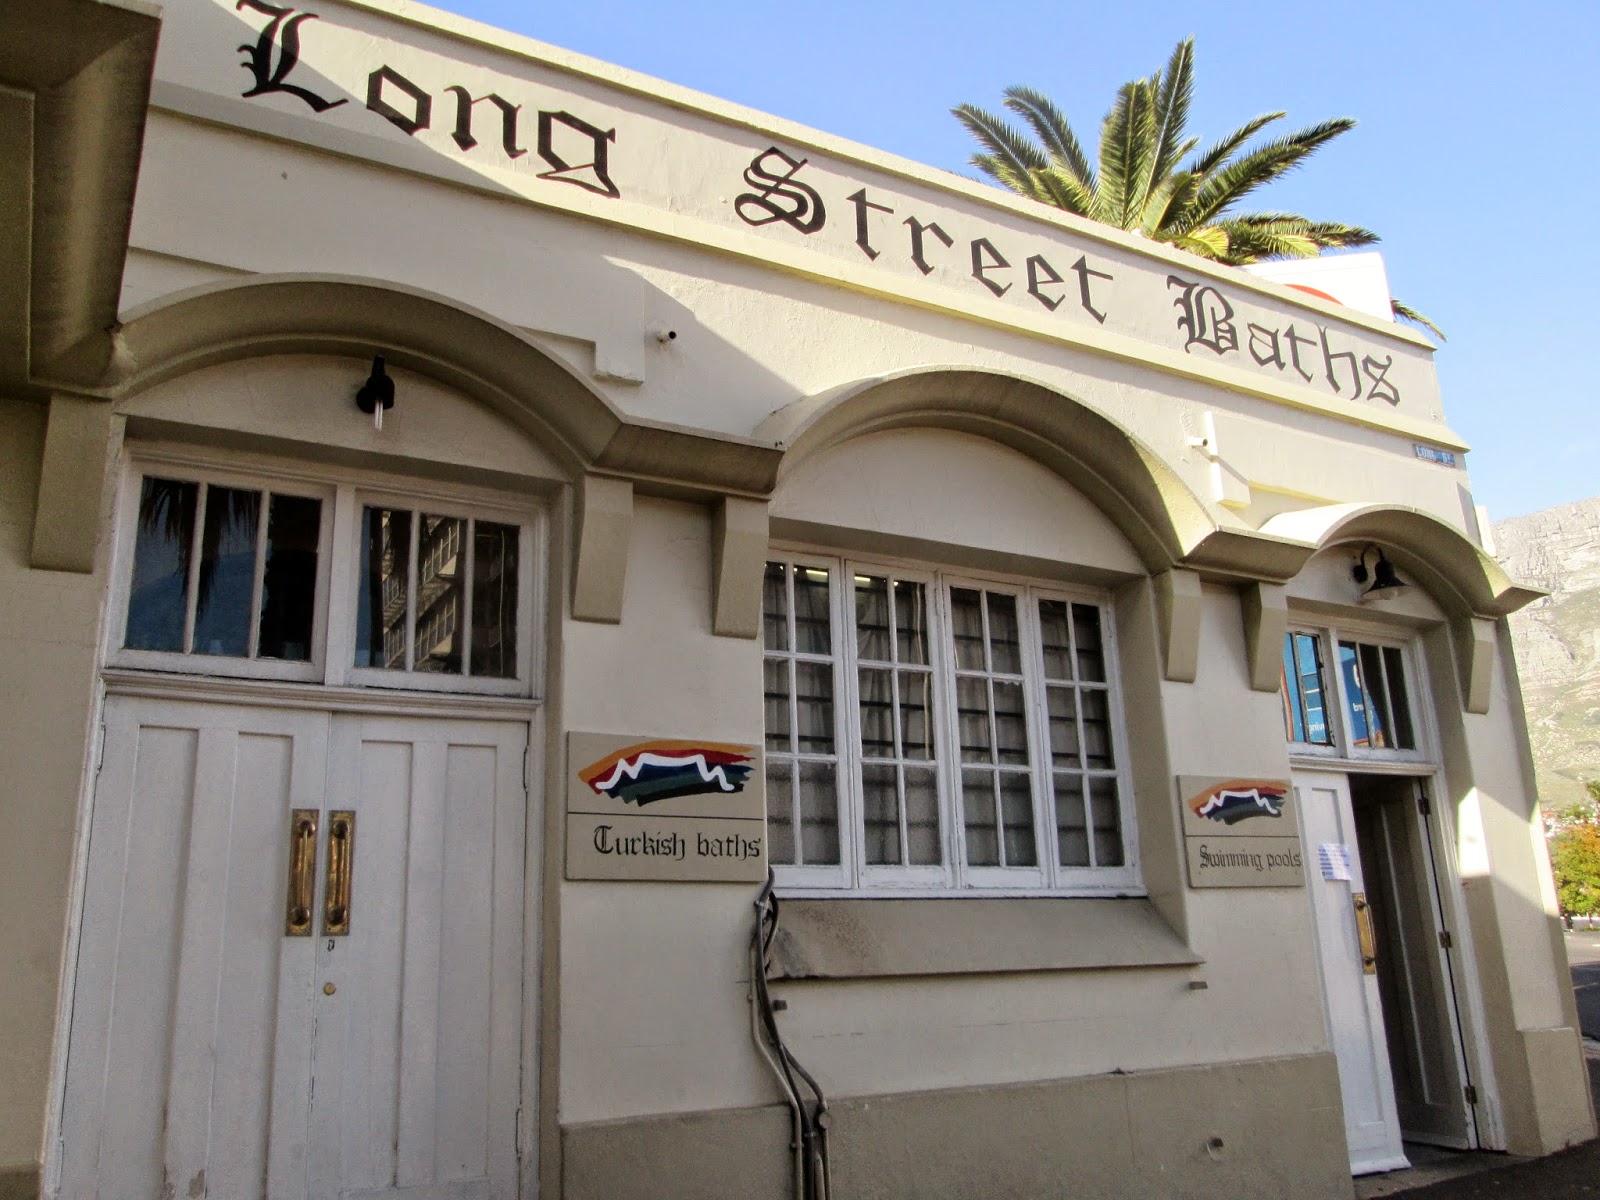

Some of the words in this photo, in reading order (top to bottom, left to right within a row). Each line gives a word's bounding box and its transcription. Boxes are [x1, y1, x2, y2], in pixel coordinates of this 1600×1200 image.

[234, 0, 621, 199] Long
[734, 146, 1114, 325] Street
[1166, 274, 1401, 406] Baths
[593, 824, 685, 861] Turkish
[696, 832, 761, 861] baths
[1267, 848, 1301, 872] pools
